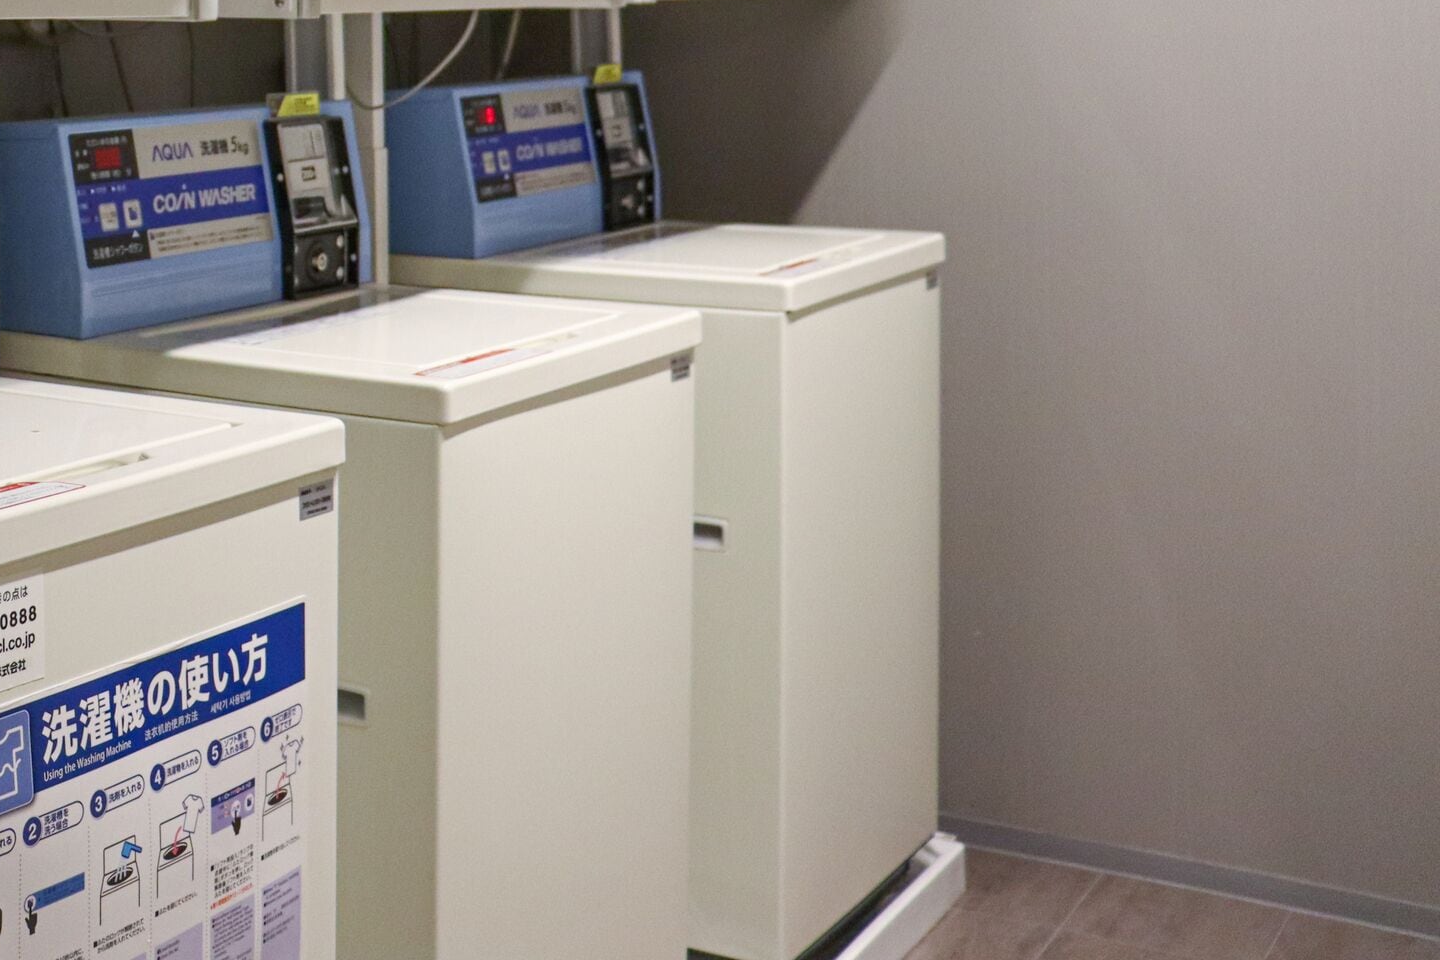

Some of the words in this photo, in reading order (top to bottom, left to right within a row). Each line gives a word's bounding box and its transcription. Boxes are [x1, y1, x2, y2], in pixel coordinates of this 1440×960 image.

[152, 141, 194, 162] AQUA
[232, 136, 250, 156] 5kg
[199, 183, 256, 207] WASHER
[42, 633, 268, 765] 洗濯機の使い方
[263, 721, 271, 737] 6
[43, 766, 63, 782] Using
[63, 762, 76, 775] the
[76, 750, 106, 770] Washing
[105, 739, 133, 758] Machine
[211, 745, 219, 761] 5
[154, 770, 162, 785] 4
[108, 782, 142, 803] 洗剤を入れる
[94, 797, 103, 812] 3
[28, 822, 37, 837] 2
[44, 819, 69, 836] 洗う場合
